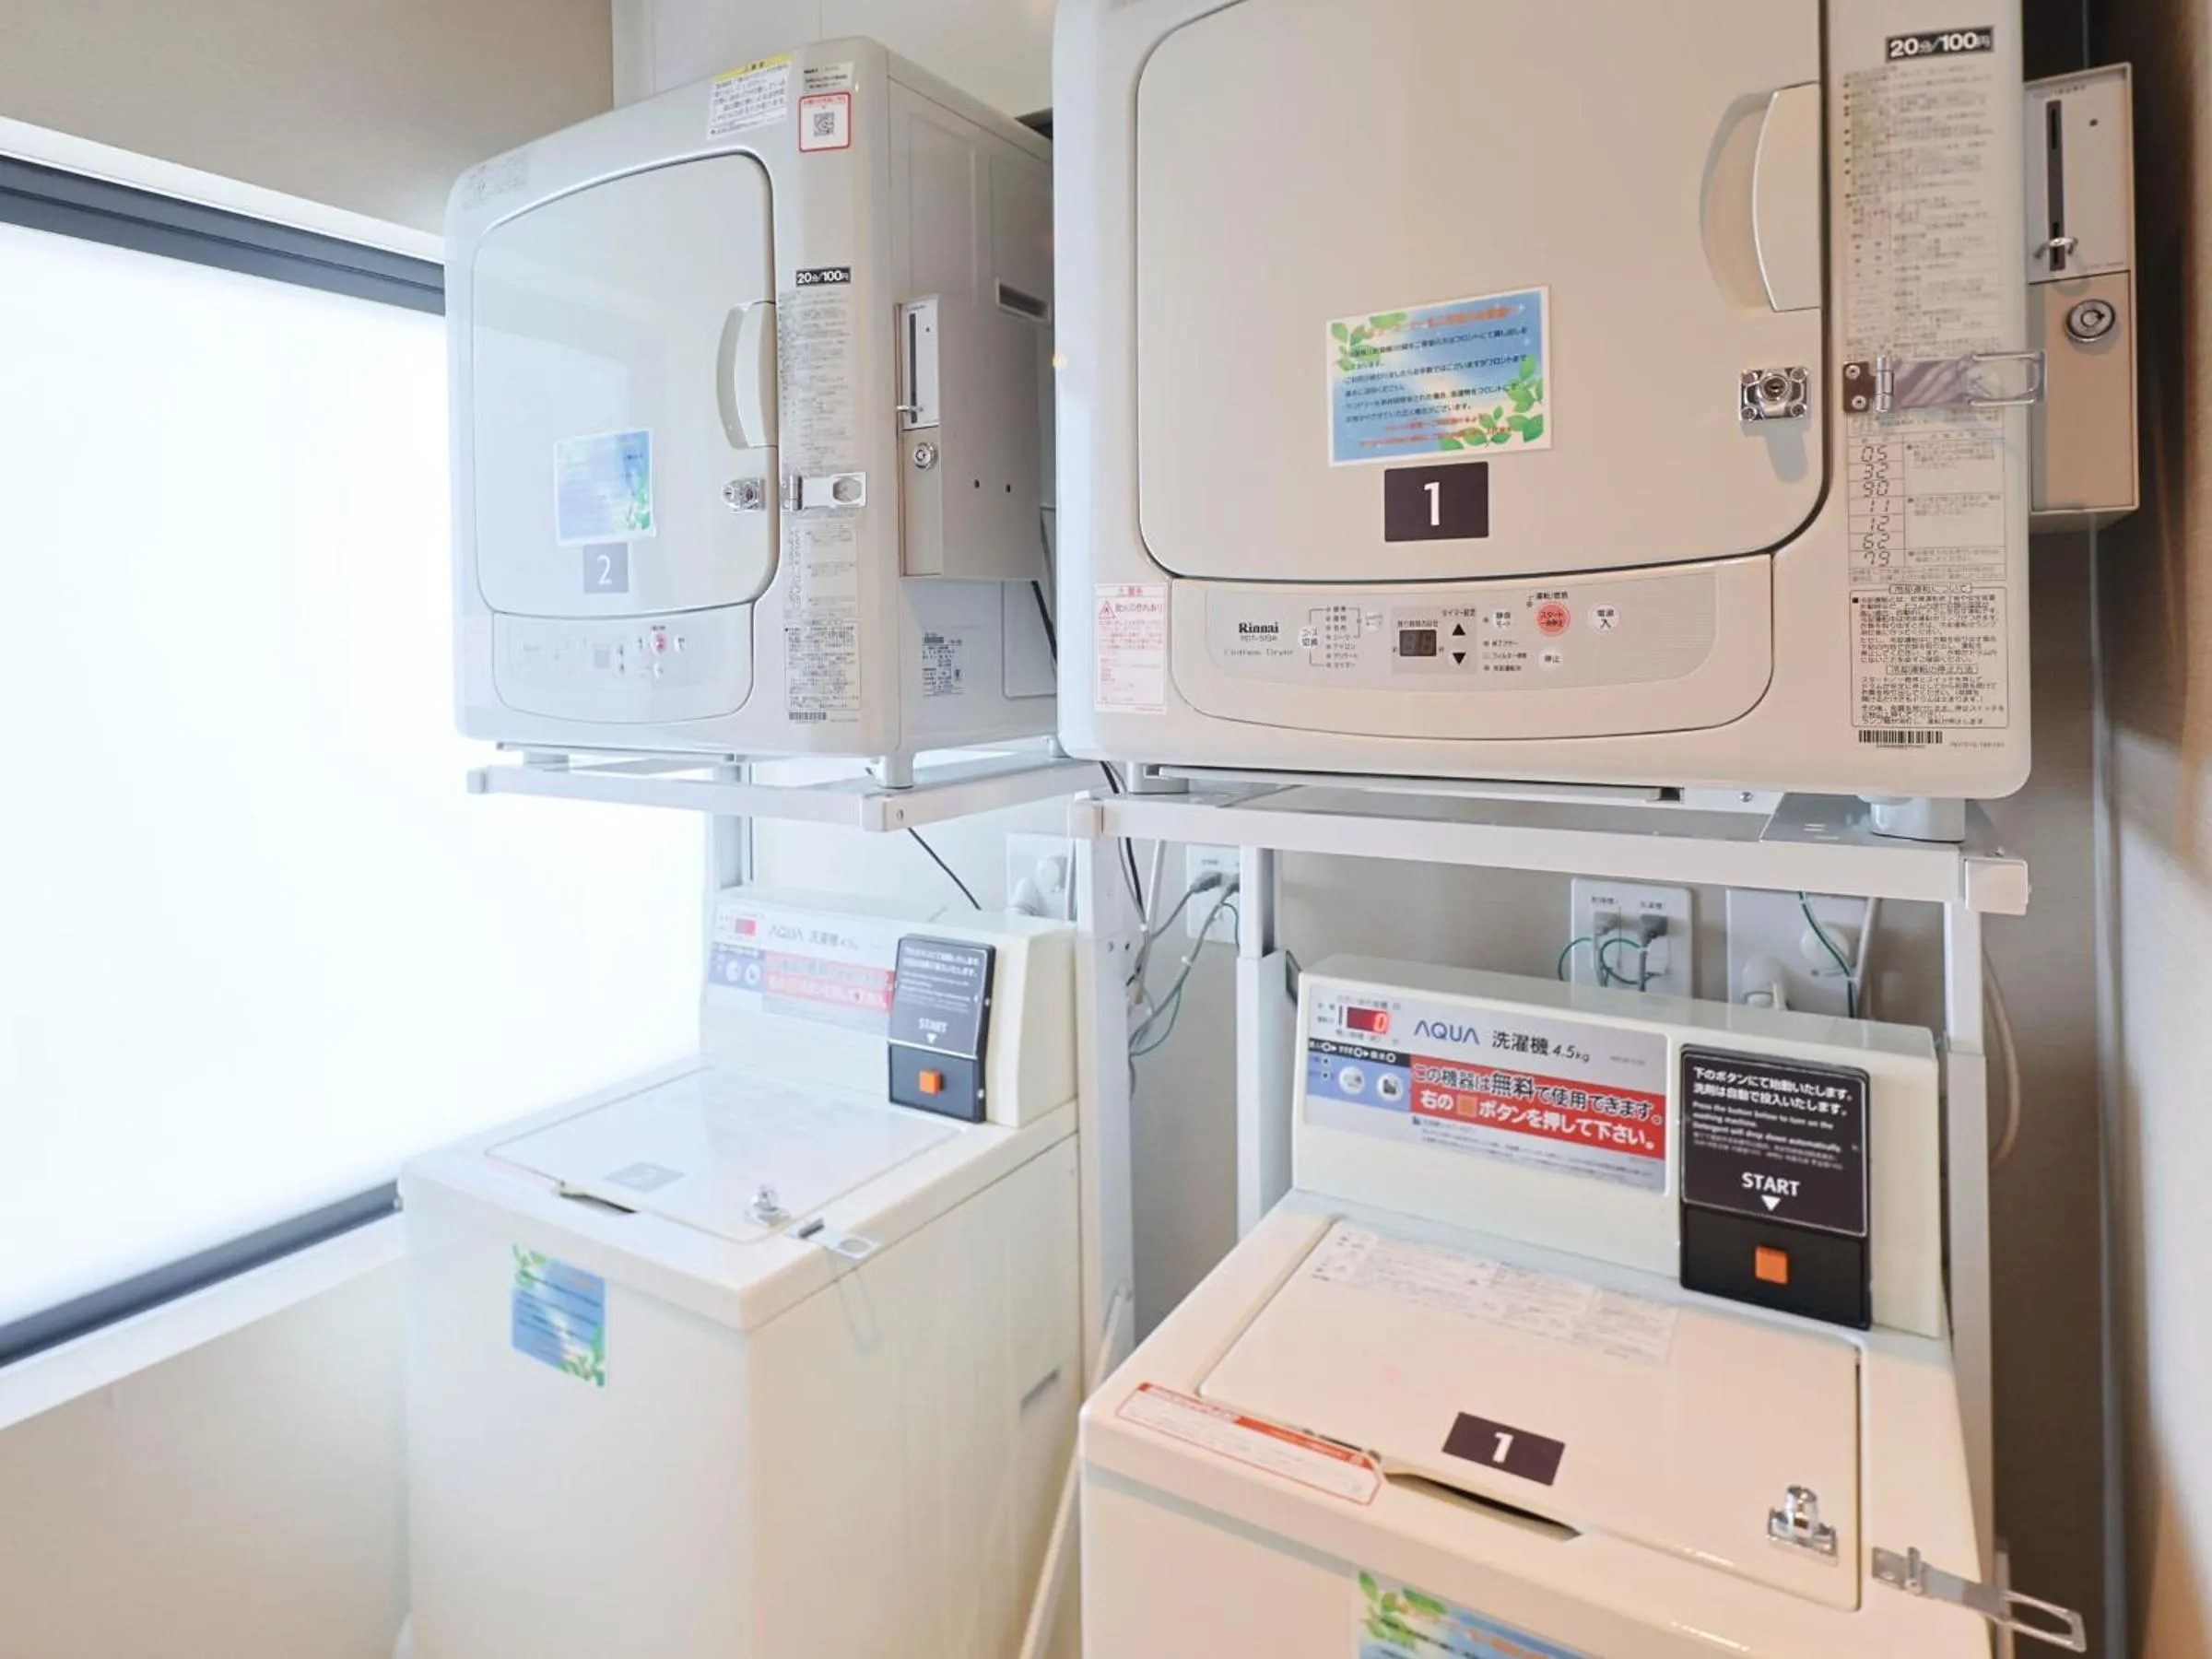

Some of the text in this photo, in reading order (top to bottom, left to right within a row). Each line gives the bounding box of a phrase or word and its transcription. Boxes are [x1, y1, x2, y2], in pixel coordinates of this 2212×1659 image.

[1889, 31, 1991, 58] 20分/100円
[1861, 445, 1888, 462] 05
[1864, 462, 1888, 479] 32
[1863, 480, 1888, 498] 90
[1423, 481, 1441, 526] 1
[1869, 514, 1889, 532] 12
[596, 554, 613, 585] 2
[1238, 621, 1279, 633] Rinnai
[1599, 618, 1612, 629] 入
[918, 1017, 948, 1034] START
[1413, 1019, 1481, 1047] AQUA
[1491, 1030, 1550, 1057] 洗濯機
[1552, 1044, 1591, 1064] 4.5kg
[1413, 1064, 1663, 1126] この機器は無料で使用できます。
[1820, 1120, 1834, 1130] the
[1741, 1171, 1801, 1197] START
[1490, 1431, 1514, 1465] 1
